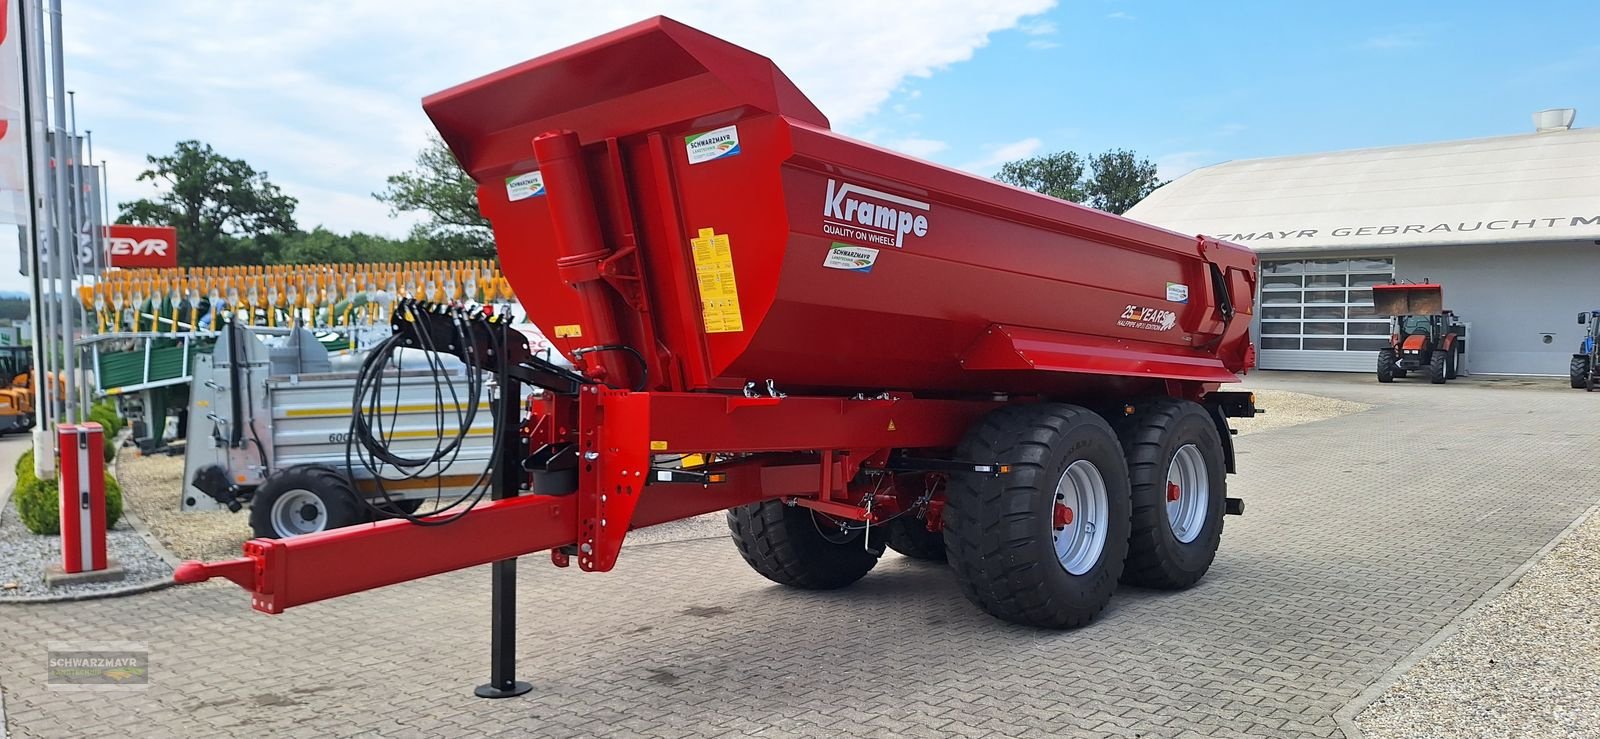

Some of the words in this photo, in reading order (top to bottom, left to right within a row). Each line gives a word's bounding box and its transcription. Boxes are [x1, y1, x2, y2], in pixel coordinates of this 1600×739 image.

[690, 134, 731, 149] SCHWARZMAYR
[824, 178, 930, 248] Krampe
[823, 224, 855, 239] QUALITY
[855, 231, 867, 241] ON
[868, 234, 896, 247] WHEELS
[1206, 229, 1318, 242] ZMAYR
[833, 249, 871, 260] SCHWARZMAYR
[1121, 304, 1137, 319] 25
[1139, 307, 1169, 324] YEARS
